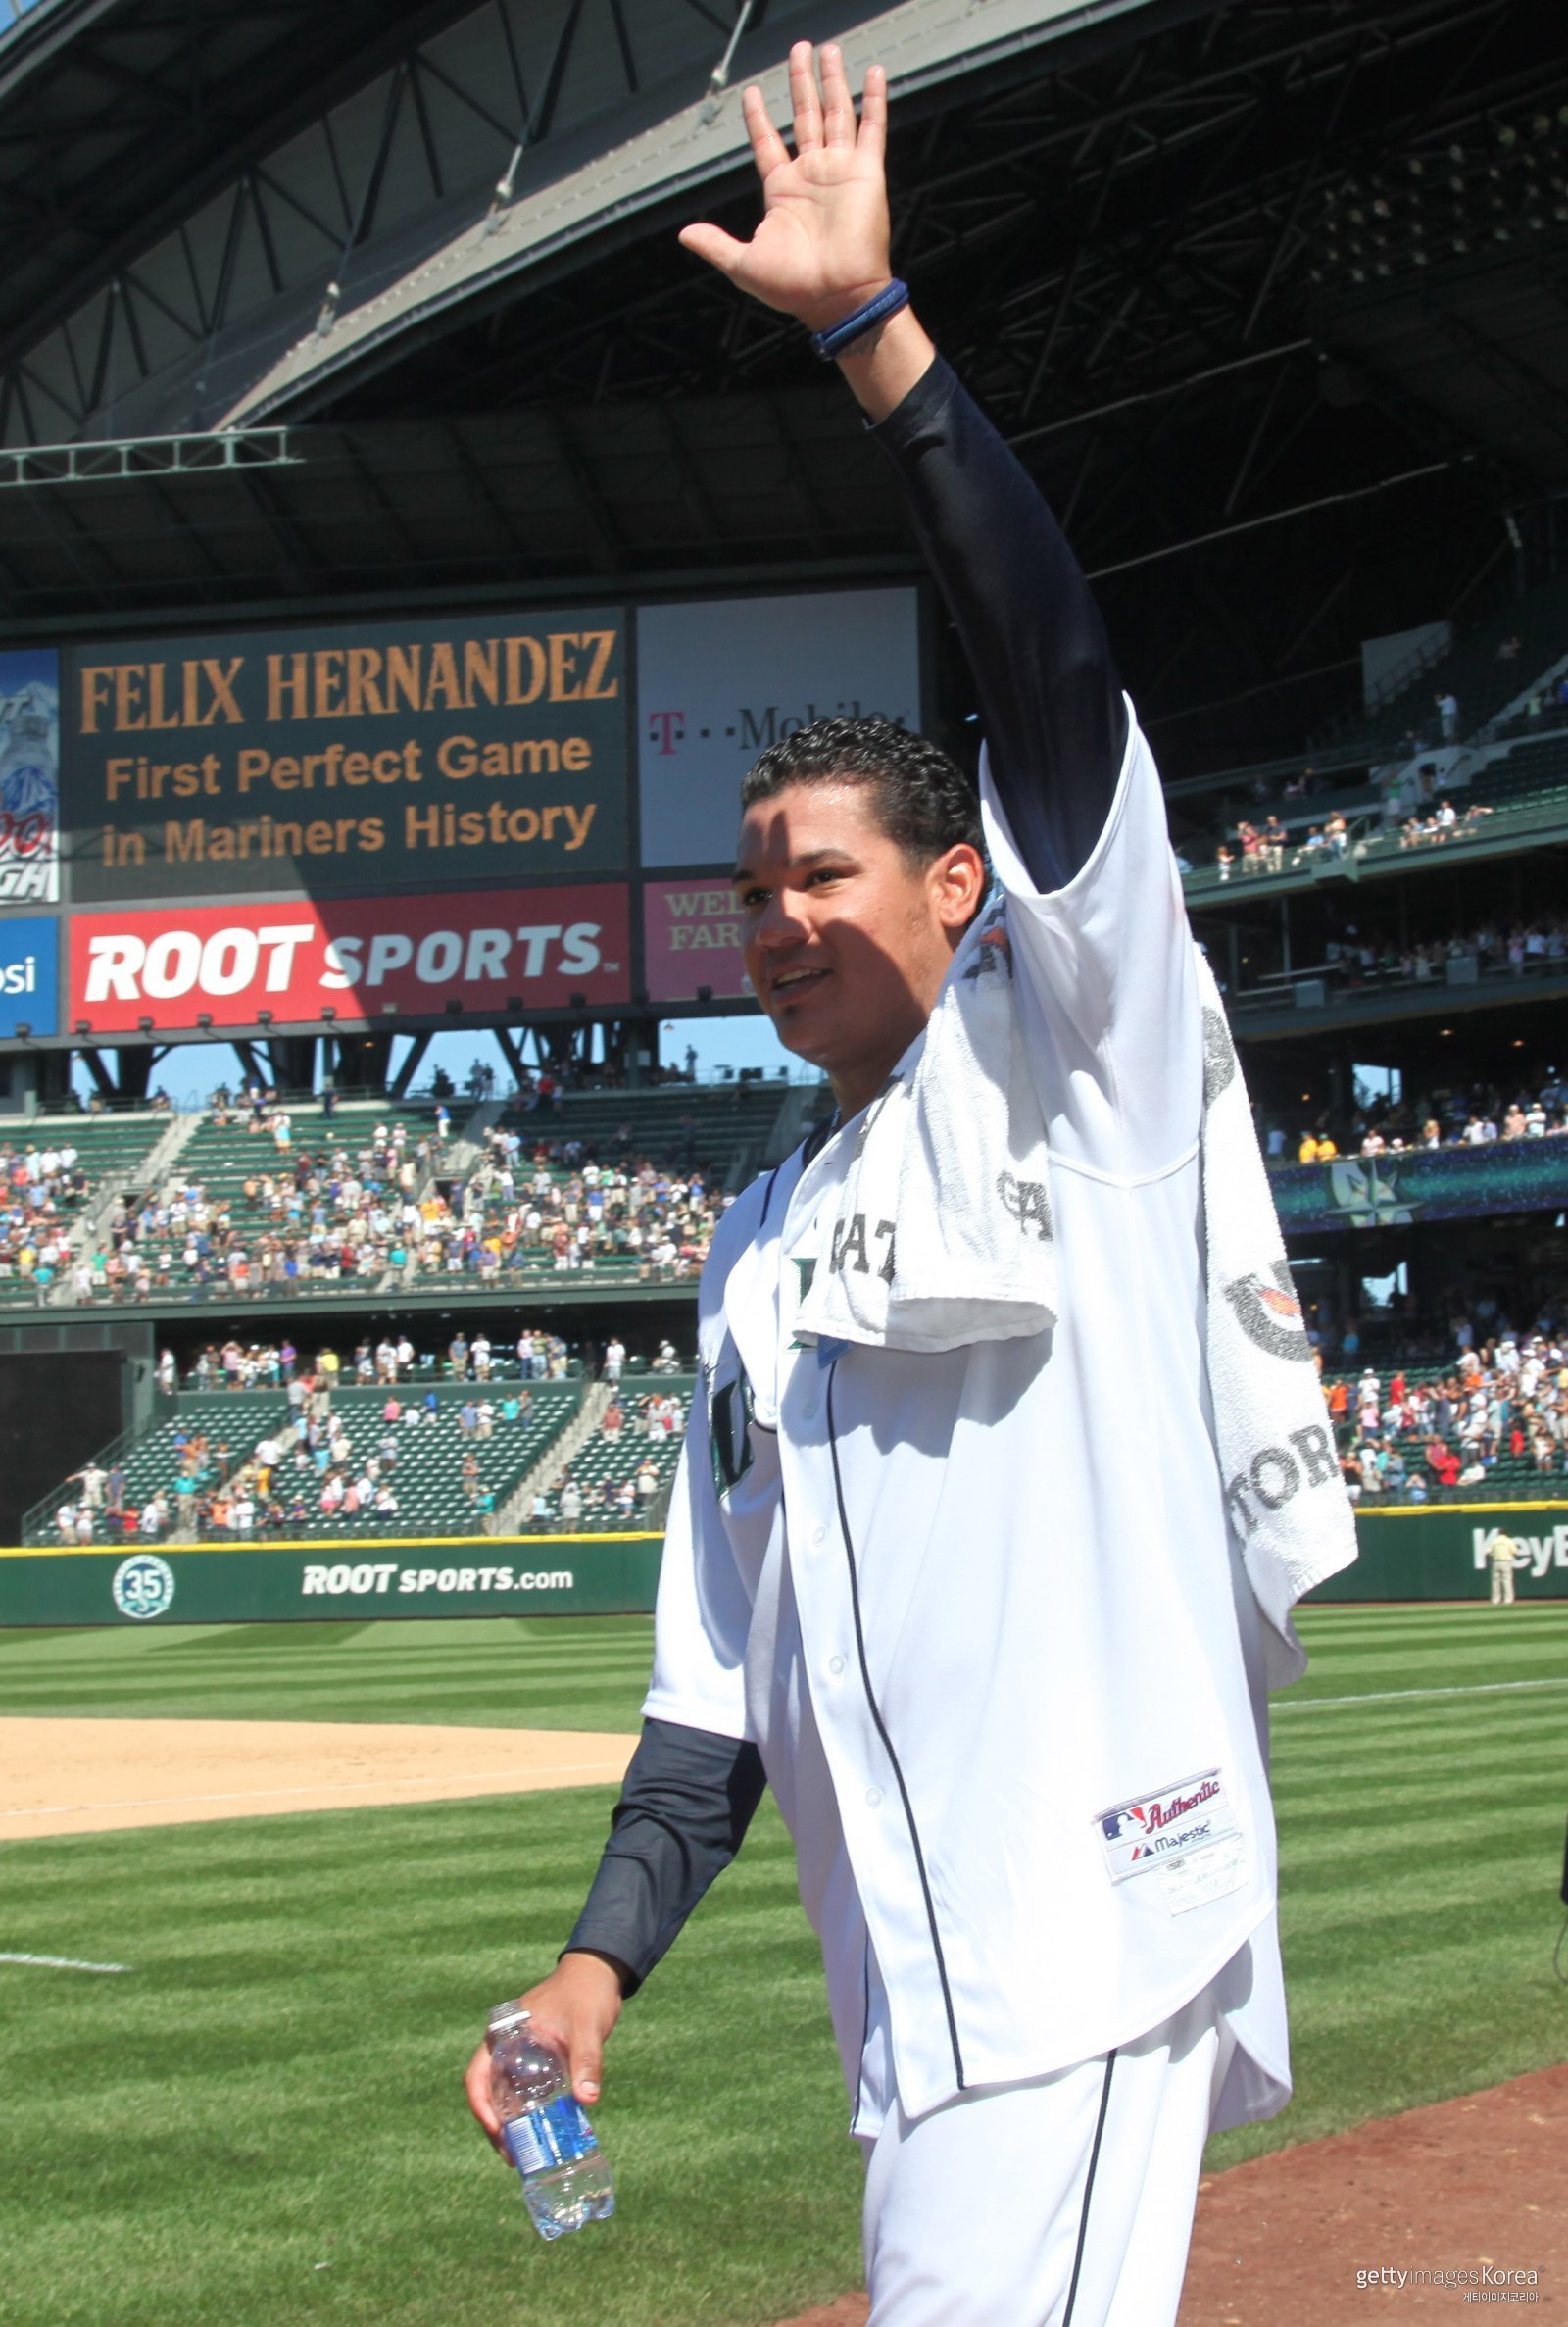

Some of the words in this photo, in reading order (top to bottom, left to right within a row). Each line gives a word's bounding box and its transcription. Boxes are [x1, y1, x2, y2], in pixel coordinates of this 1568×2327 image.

[79, 657, 245, 734] FELIX
[266, 630, 619, 720] HERNANDEZ
[105, 751, 221, 801] First
[237, 740, 422, 792] Perfect
[437, 735, 592, 779] Game
[103, 825, 145, 867] in
[165, 815, 386, 864] Mariners
[405, 802, 599, 852] History
[663, 889, 746, 917] WEL
[668, 922, 743, 951] FAR
[0, 955, 35, 994] si
[84, 924, 315, 1002] ROOT
[318, 922, 602, 989] SPORTS
[124, 1569, 163, 1600] 35
[302, 1563, 398, 1594] ROOT
[398, 1567, 573, 1593] SPORTS.com
[1145, 1780, 1220, 1834] Authentic
[1154, 1823, 1211, 1853] Majestic
